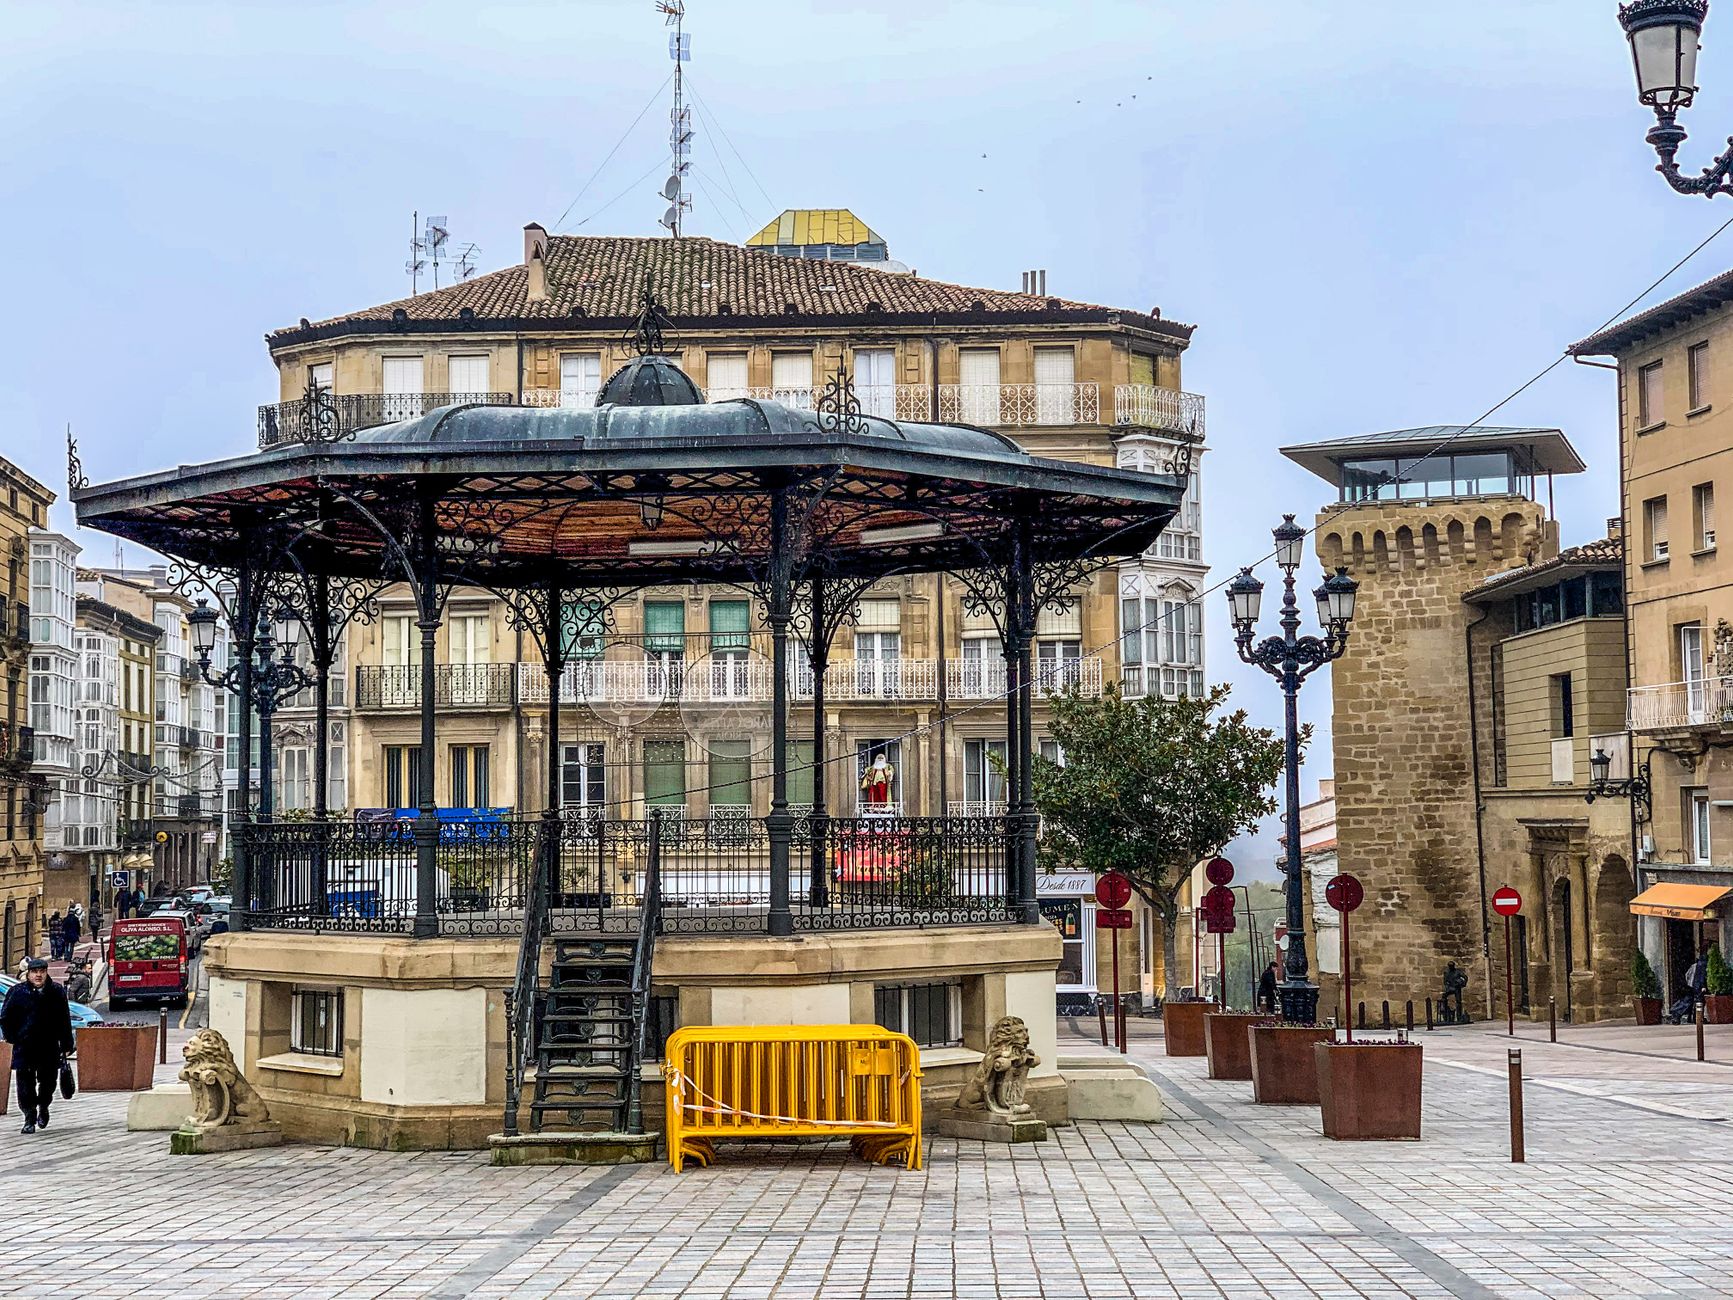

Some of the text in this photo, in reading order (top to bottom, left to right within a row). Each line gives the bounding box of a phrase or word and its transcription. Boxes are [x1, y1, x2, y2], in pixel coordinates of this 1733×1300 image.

[1037, 875, 1087, 892] Desde 1887
[1041, 903, 1079, 914] UMEN
